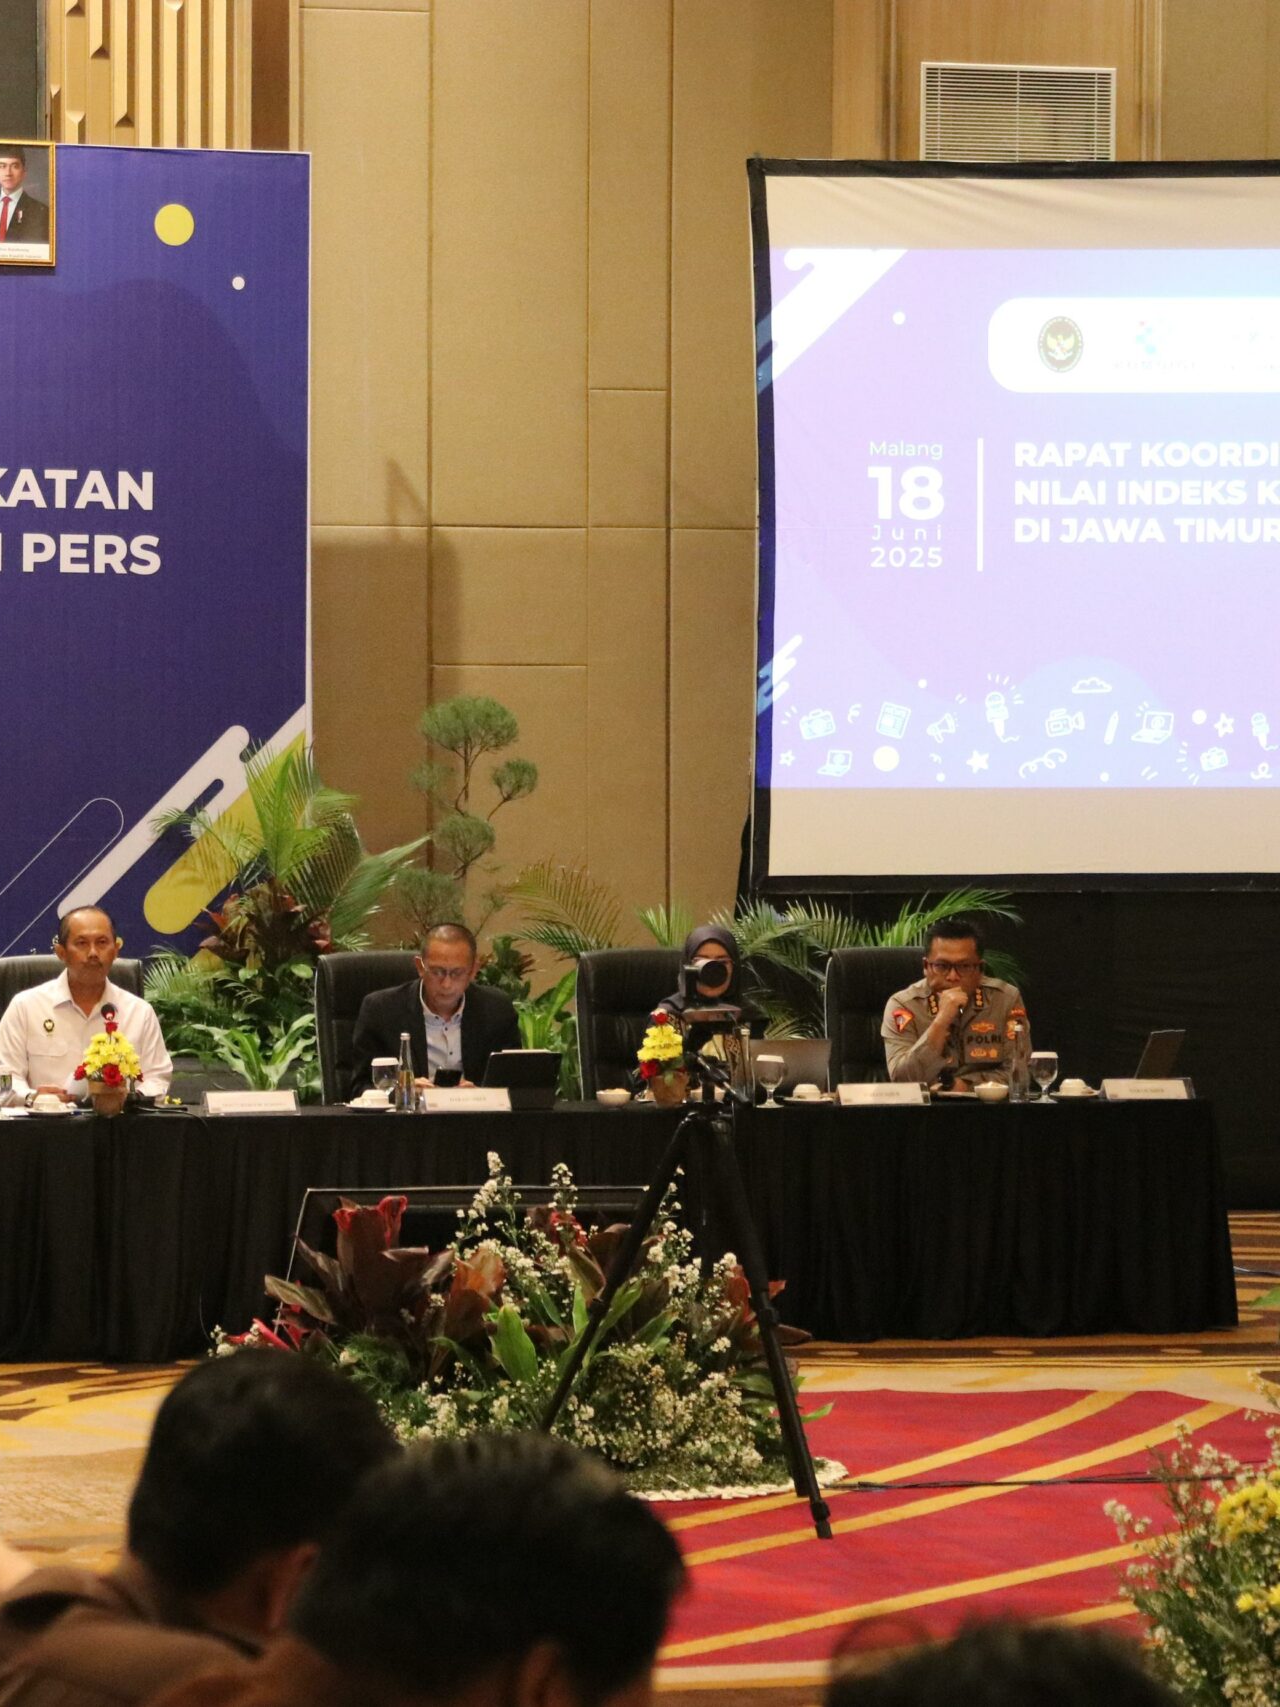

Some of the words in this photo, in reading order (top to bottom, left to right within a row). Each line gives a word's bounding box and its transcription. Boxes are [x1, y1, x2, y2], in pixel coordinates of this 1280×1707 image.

[869, 439, 944, 461] Malang
[1014, 441, 1132, 468] RAPAT
[867, 465, 945, 520] 18
[1014, 479, 1107, 506] NILAI
[1117, 479, 1248, 506] INDEKS
[871, 524, 942, 541] Juni
[1014, 517, 1051, 543] DI
[1060, 517, 1166, 544] JAWA
[1173, 517, 1280, 544] TIMUR
[23, 532, 161, 575] PERS
[870, 545, 943, 568] 2025
[967, 1033, 1002, 1045] POLRI
